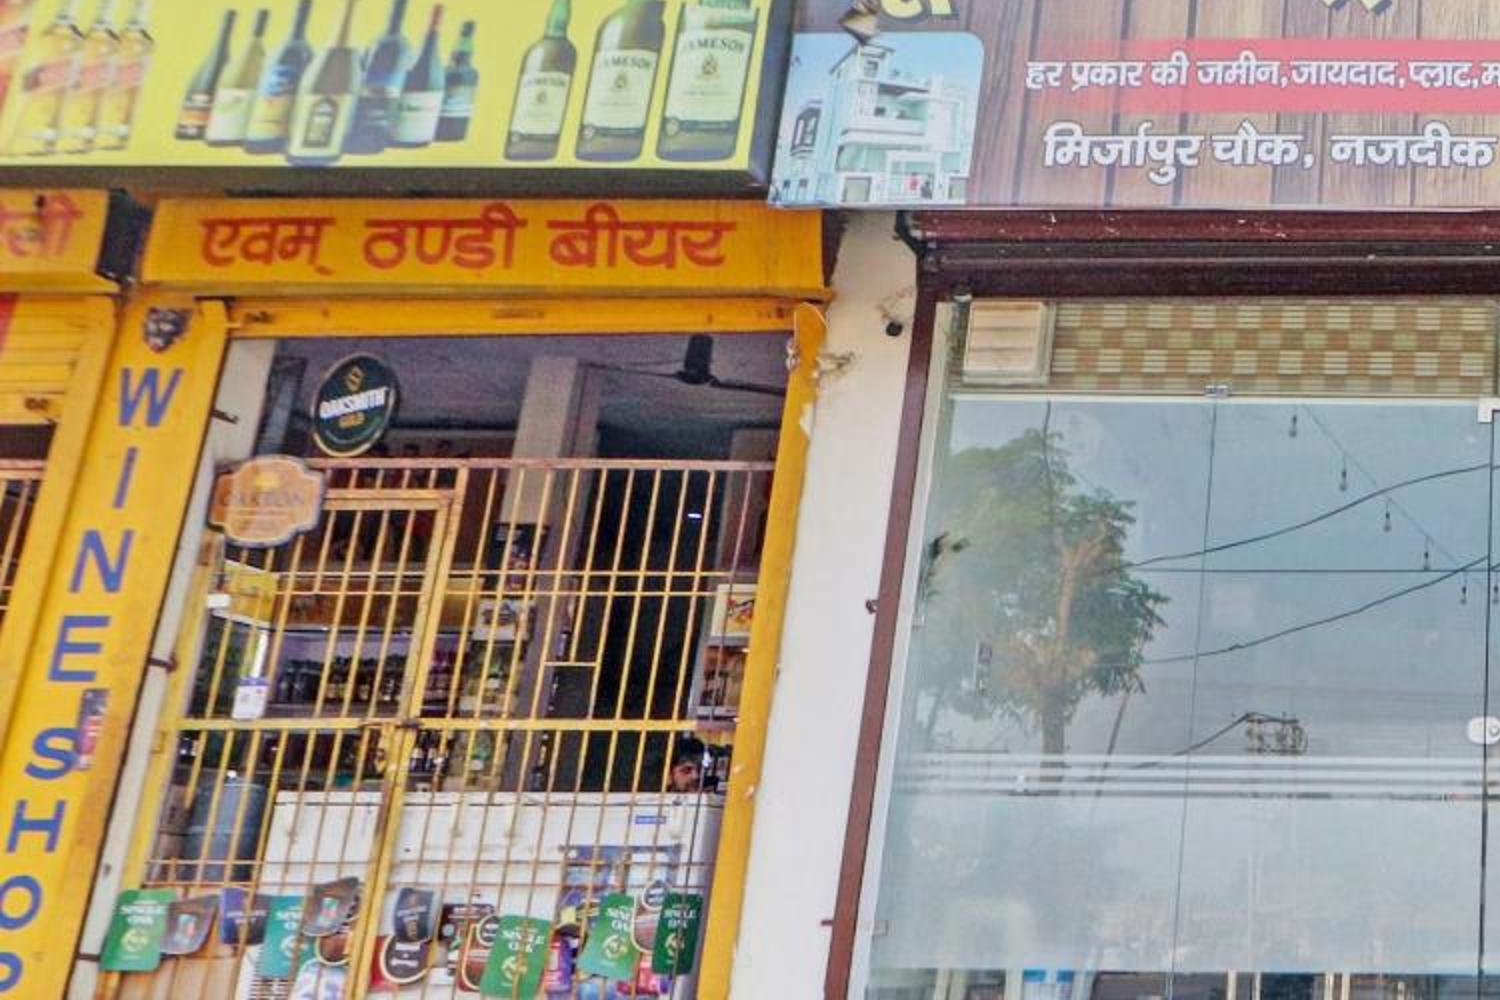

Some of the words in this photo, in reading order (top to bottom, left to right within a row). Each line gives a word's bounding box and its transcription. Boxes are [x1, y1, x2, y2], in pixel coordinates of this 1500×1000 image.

[1025, 60, 1064, 90] हर
[1071, 60, 1146, 92] प्रकार
[1151, 50, 1192, 87] की
[1042, 119, 1204, 186] मिर्जापुर
[1330, 119, 1498, 168] नजदीक
[199, 217, 332, 276] एवम्
[364, 202, 527, 273] ठण्डी
[548, 202, 737, 271] बीयर
[46, 367, 183, 683] WINE
